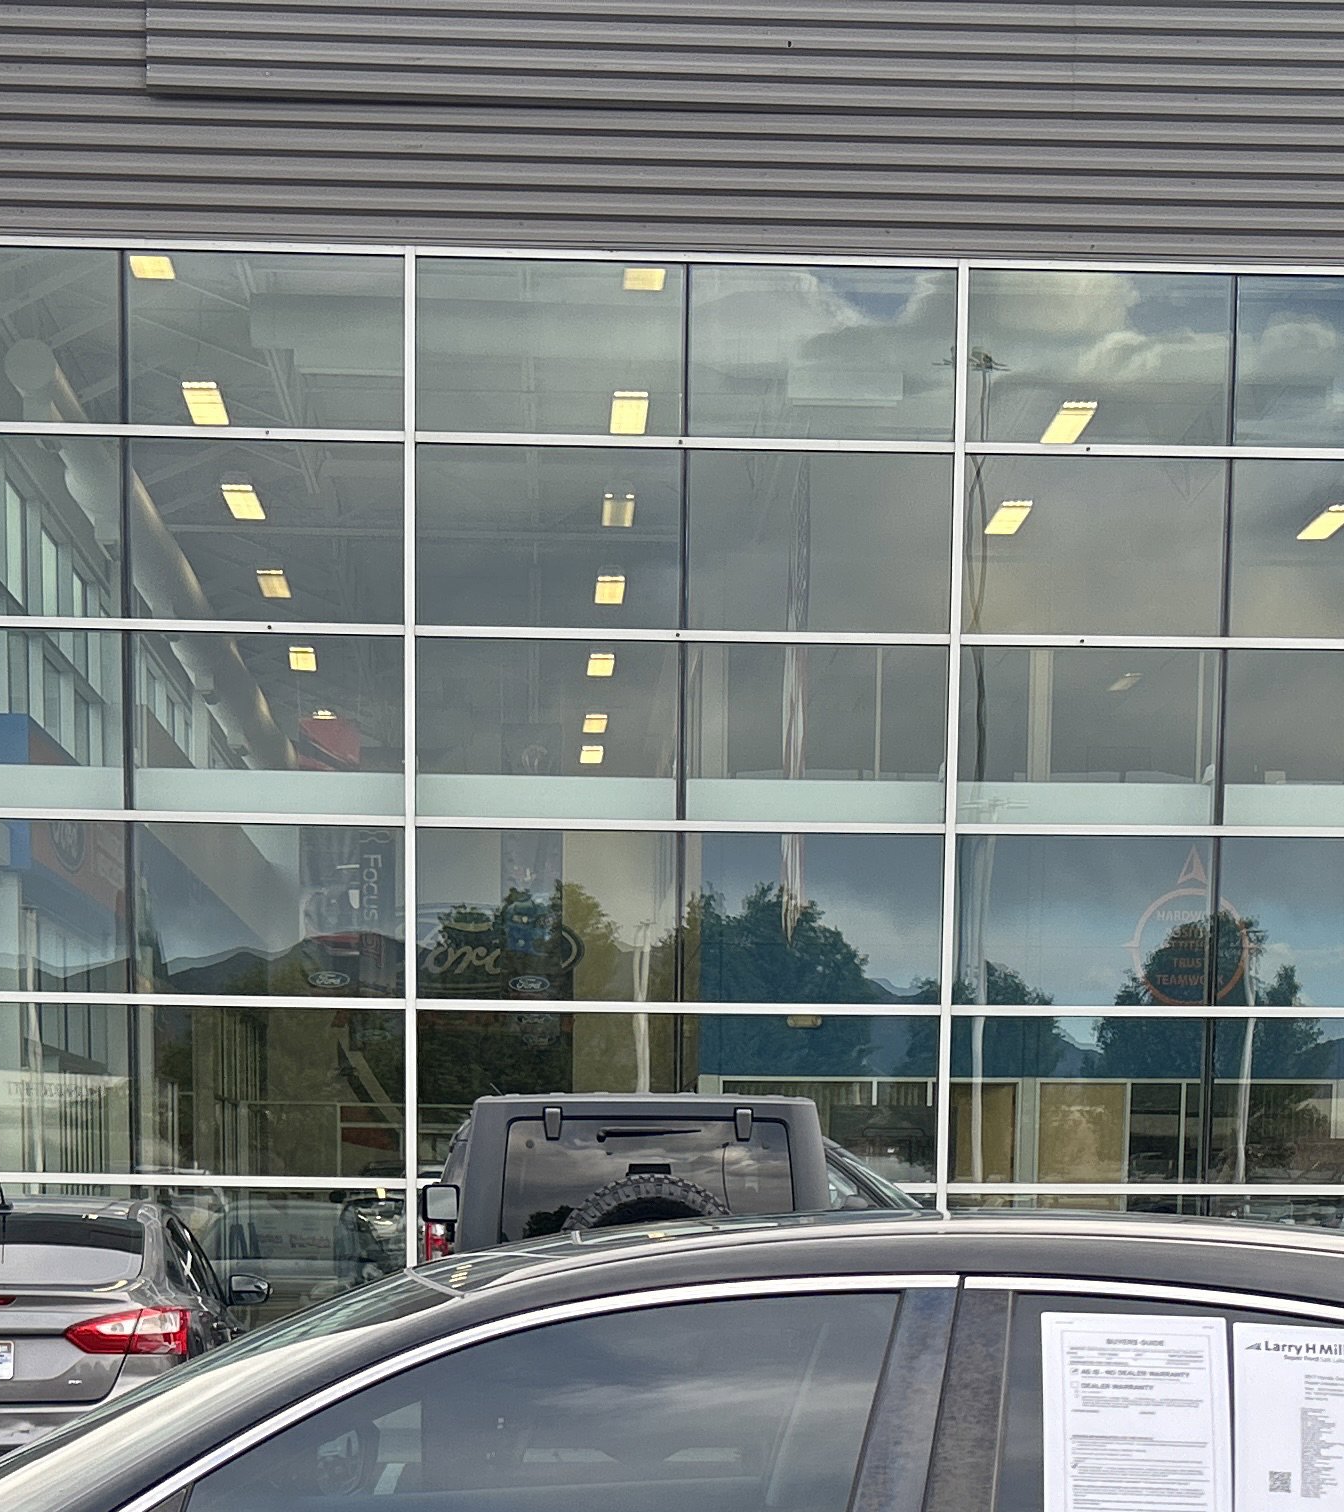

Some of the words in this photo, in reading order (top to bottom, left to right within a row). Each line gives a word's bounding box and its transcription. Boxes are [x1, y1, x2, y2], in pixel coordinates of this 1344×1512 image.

[362, 854, 383, 921] FOCUS
[1264, 1340, 1303, 1355] Larry
[1306, 1343, 1316, 1354] H
